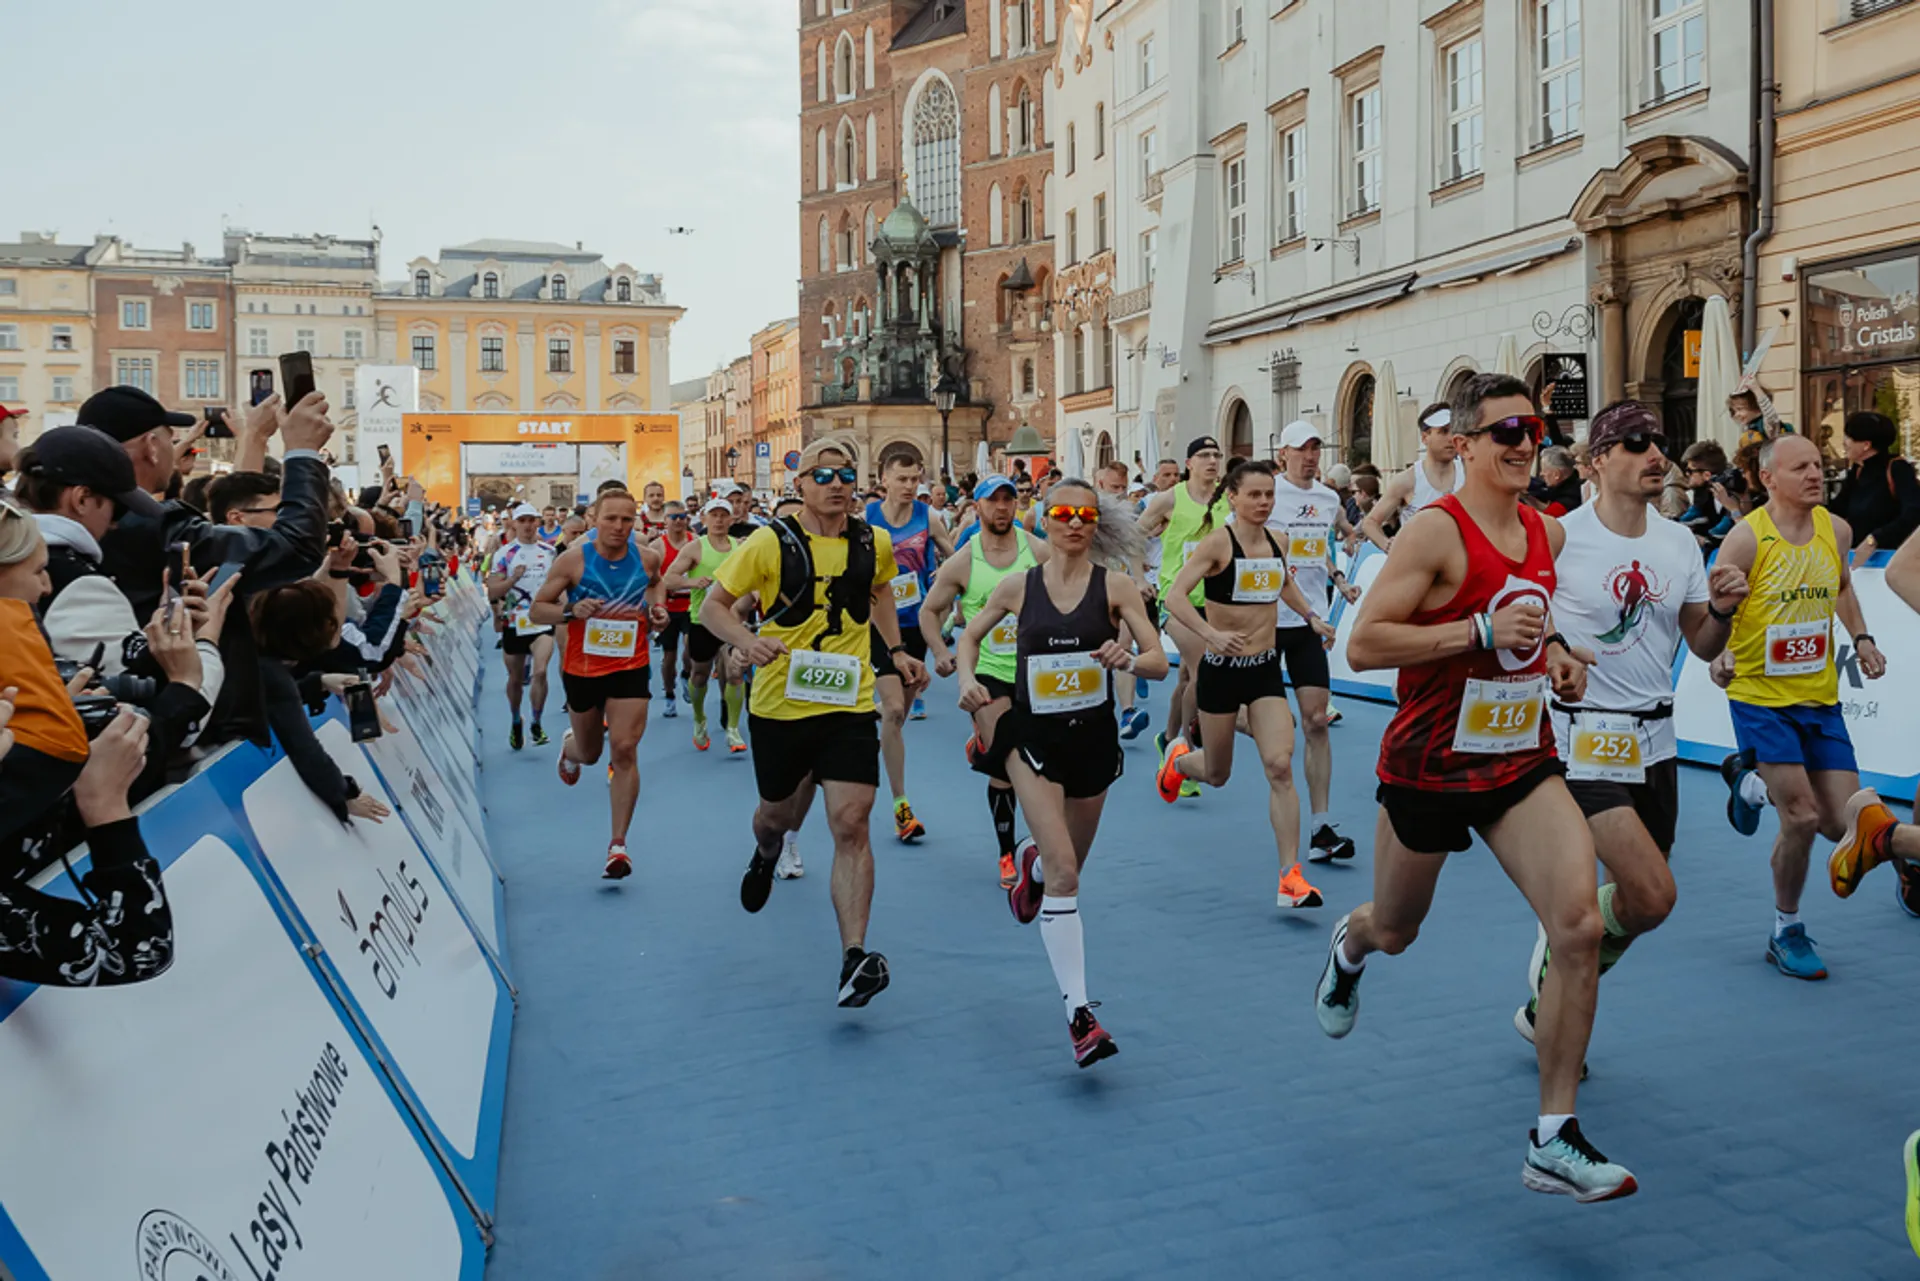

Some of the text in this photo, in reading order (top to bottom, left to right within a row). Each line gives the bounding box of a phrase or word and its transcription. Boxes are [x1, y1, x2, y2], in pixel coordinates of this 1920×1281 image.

[1857, 305, 1888, 322] Polish
[1857, 320, 1916, 347] Cristals
[518, 421, 573, 434] START
[759, 444, 769, 456] P
[1253, 571, 1270, 587] 93
[598, 631, 624, 644] 284
[1785, 638, 1818, 657] 536
[801, 666, 847, 688] 4978
[1055, 671, 1081, 692] 24
[1487, 703, 1527, 728] 116
[1842, 698, 1864, 720] alny
[1591, 735, 1633, 759] 252
[360, 860, 429, 1000] amplus
[229, 1041, 349, 1281] Lasy Państwowe
